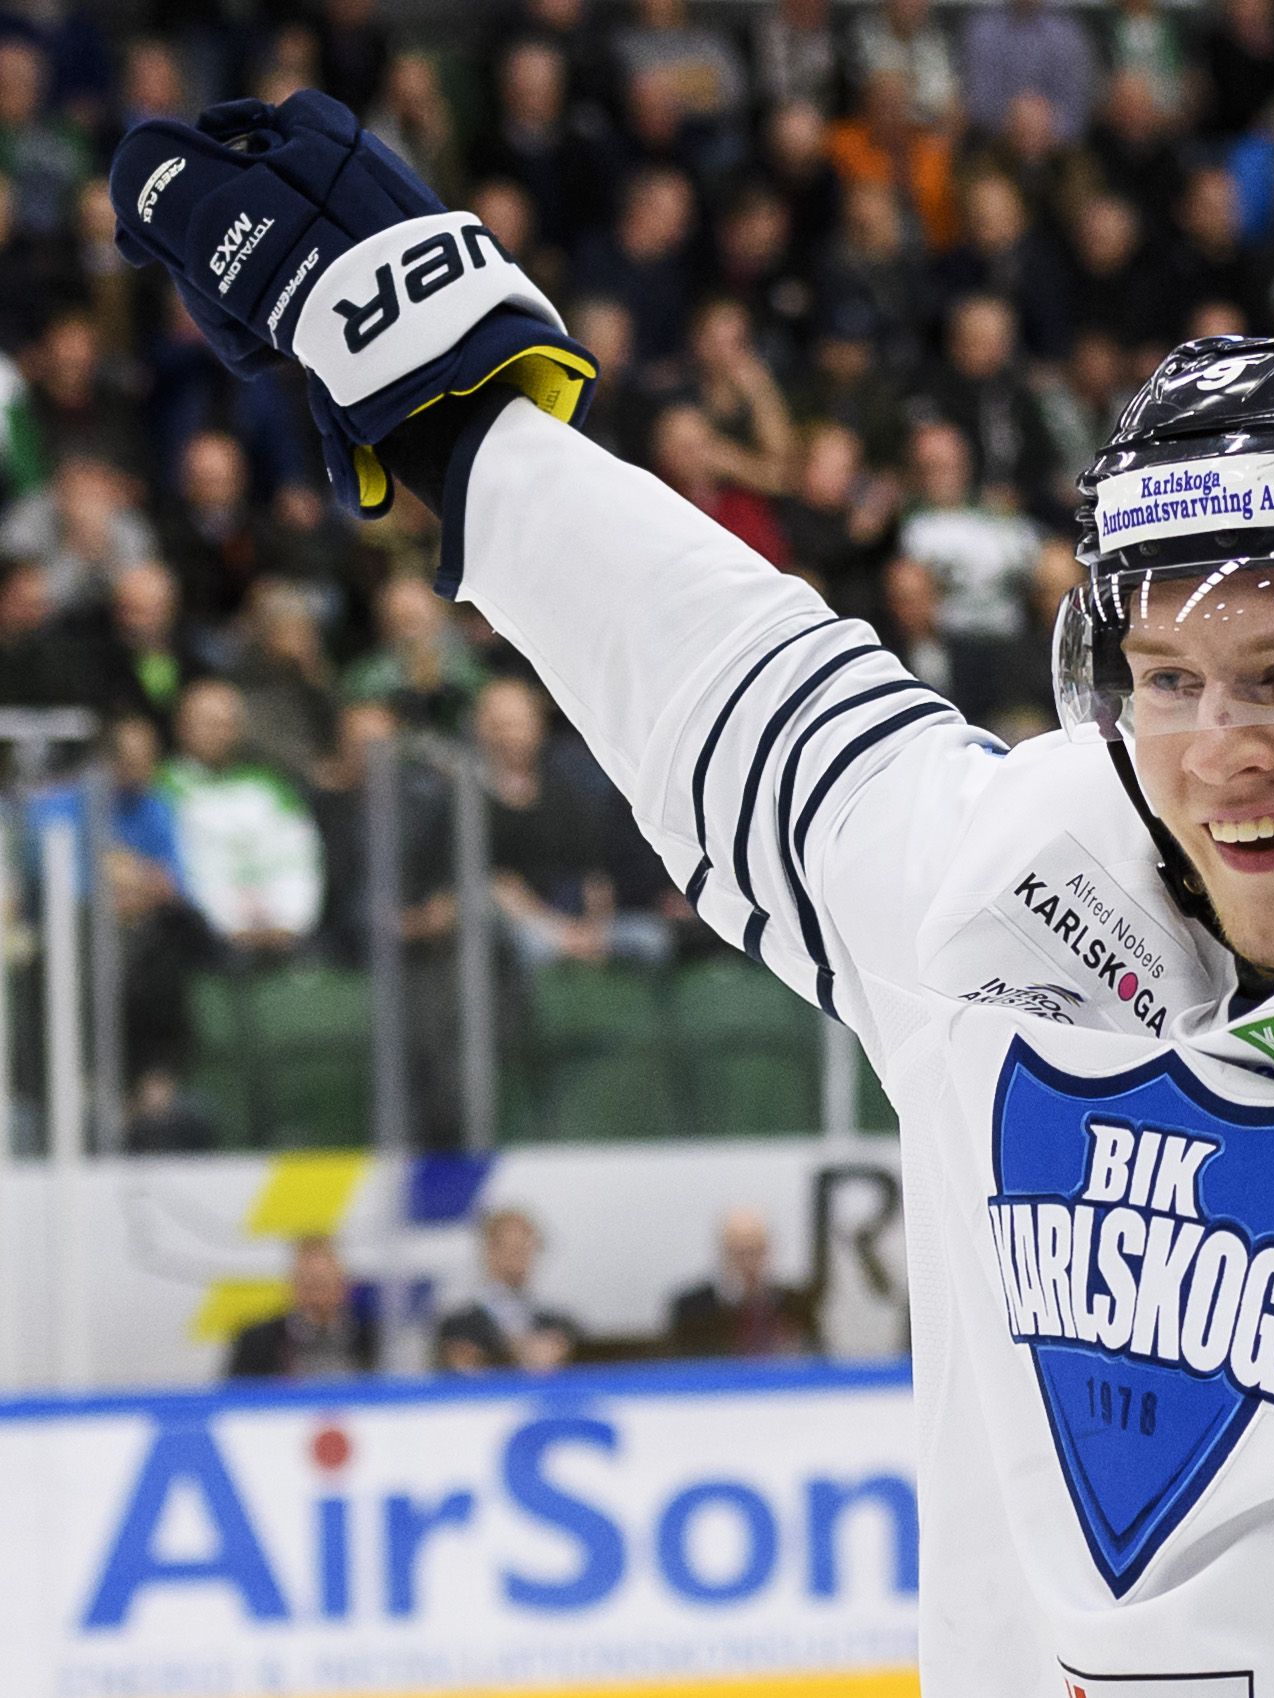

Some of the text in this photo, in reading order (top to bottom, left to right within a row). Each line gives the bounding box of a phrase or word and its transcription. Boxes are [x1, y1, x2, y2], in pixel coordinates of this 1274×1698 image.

[154, 158, 186, 191] FREE
[209, 212, 252, 276] MX3
[218, 217, 275, 297] TOTALONE
[267, 248, 320, 332] SUPREME
[332, 225, 515, 354] UER
[1103, 487, 1253, 537] Automatsvarvning
[1141, 470, 1220, 498] Karlskoga
[1014, 872, 1167, 1039] KARLSKOGA
[1065, 873, 1164, 979] Alfred Nobels
[1083, 1124, 1217, 1219] BIK
[1086, 1376, 1158, 1437] 1978
